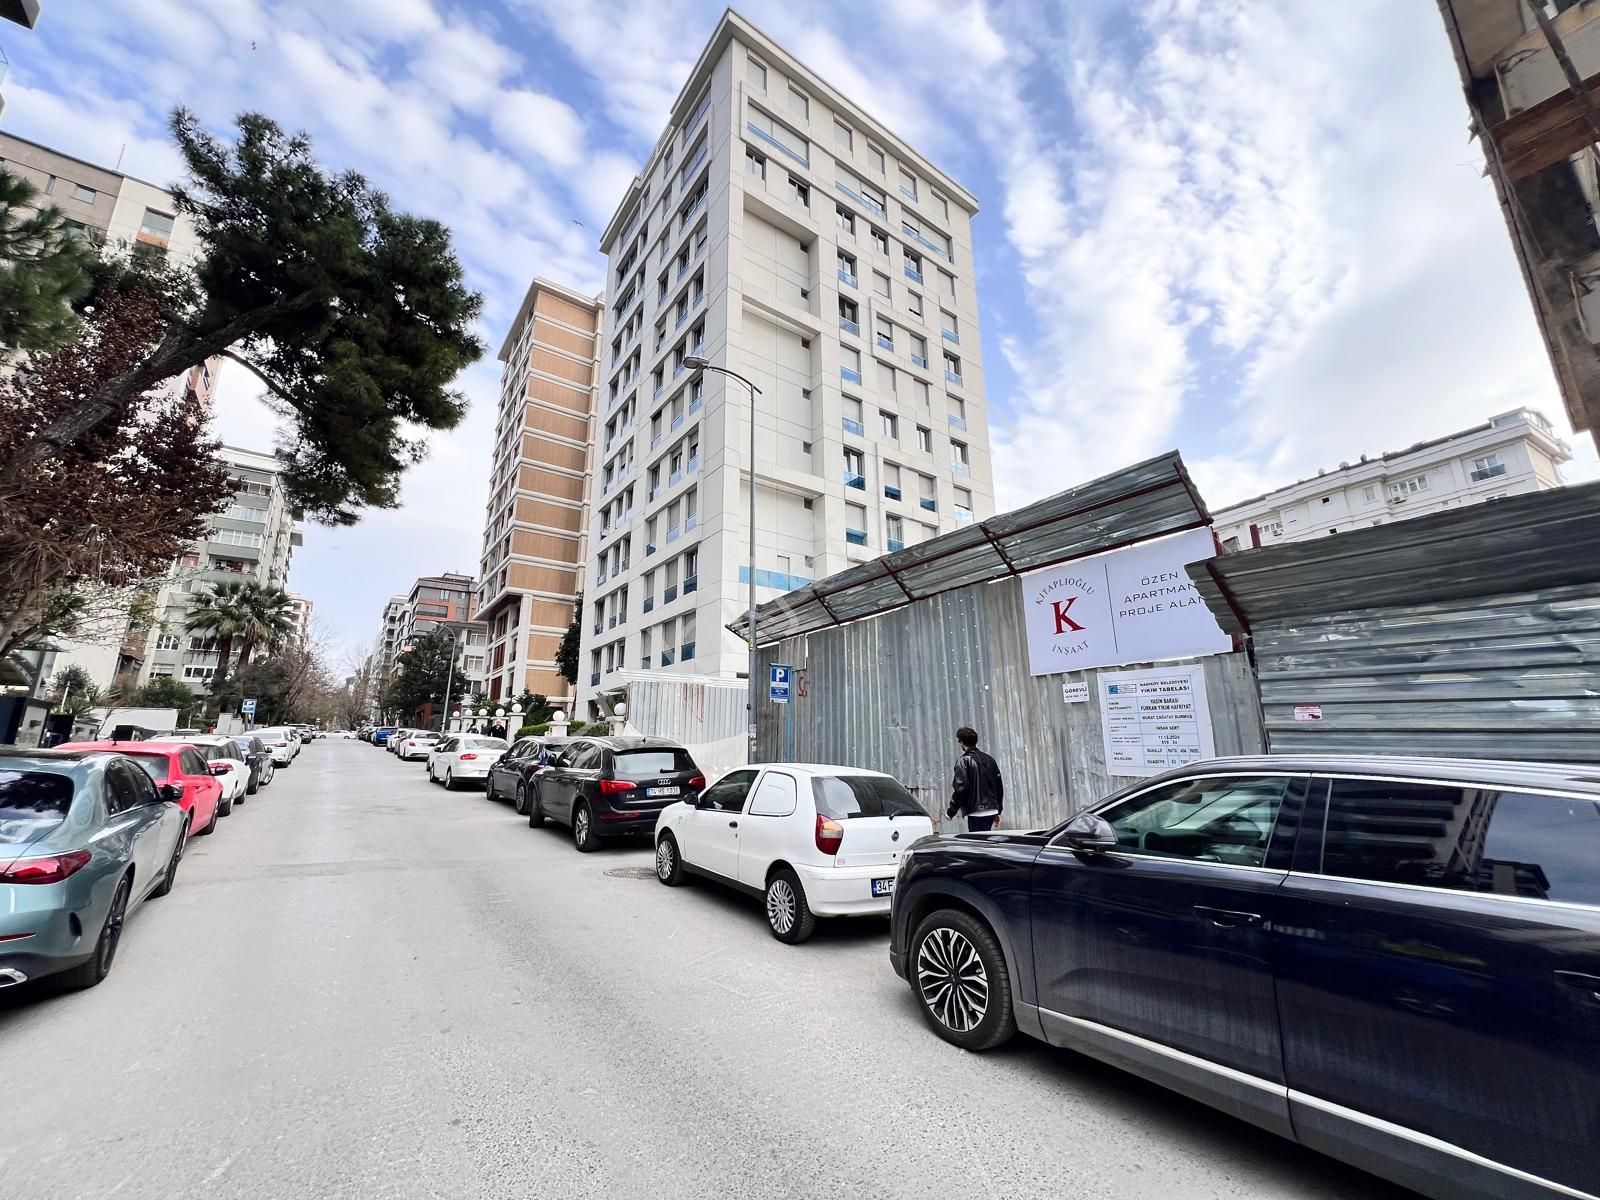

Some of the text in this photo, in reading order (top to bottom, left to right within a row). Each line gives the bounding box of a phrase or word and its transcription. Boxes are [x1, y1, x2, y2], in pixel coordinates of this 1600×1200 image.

[1141, 572, 1178, 586] ÖZEN
[1050, 596, 1087, 635] K
[1119, 603, 1164, 618] PROJE
[776, 668, 785, 682] P
[877, 880, 887, 891] 34
